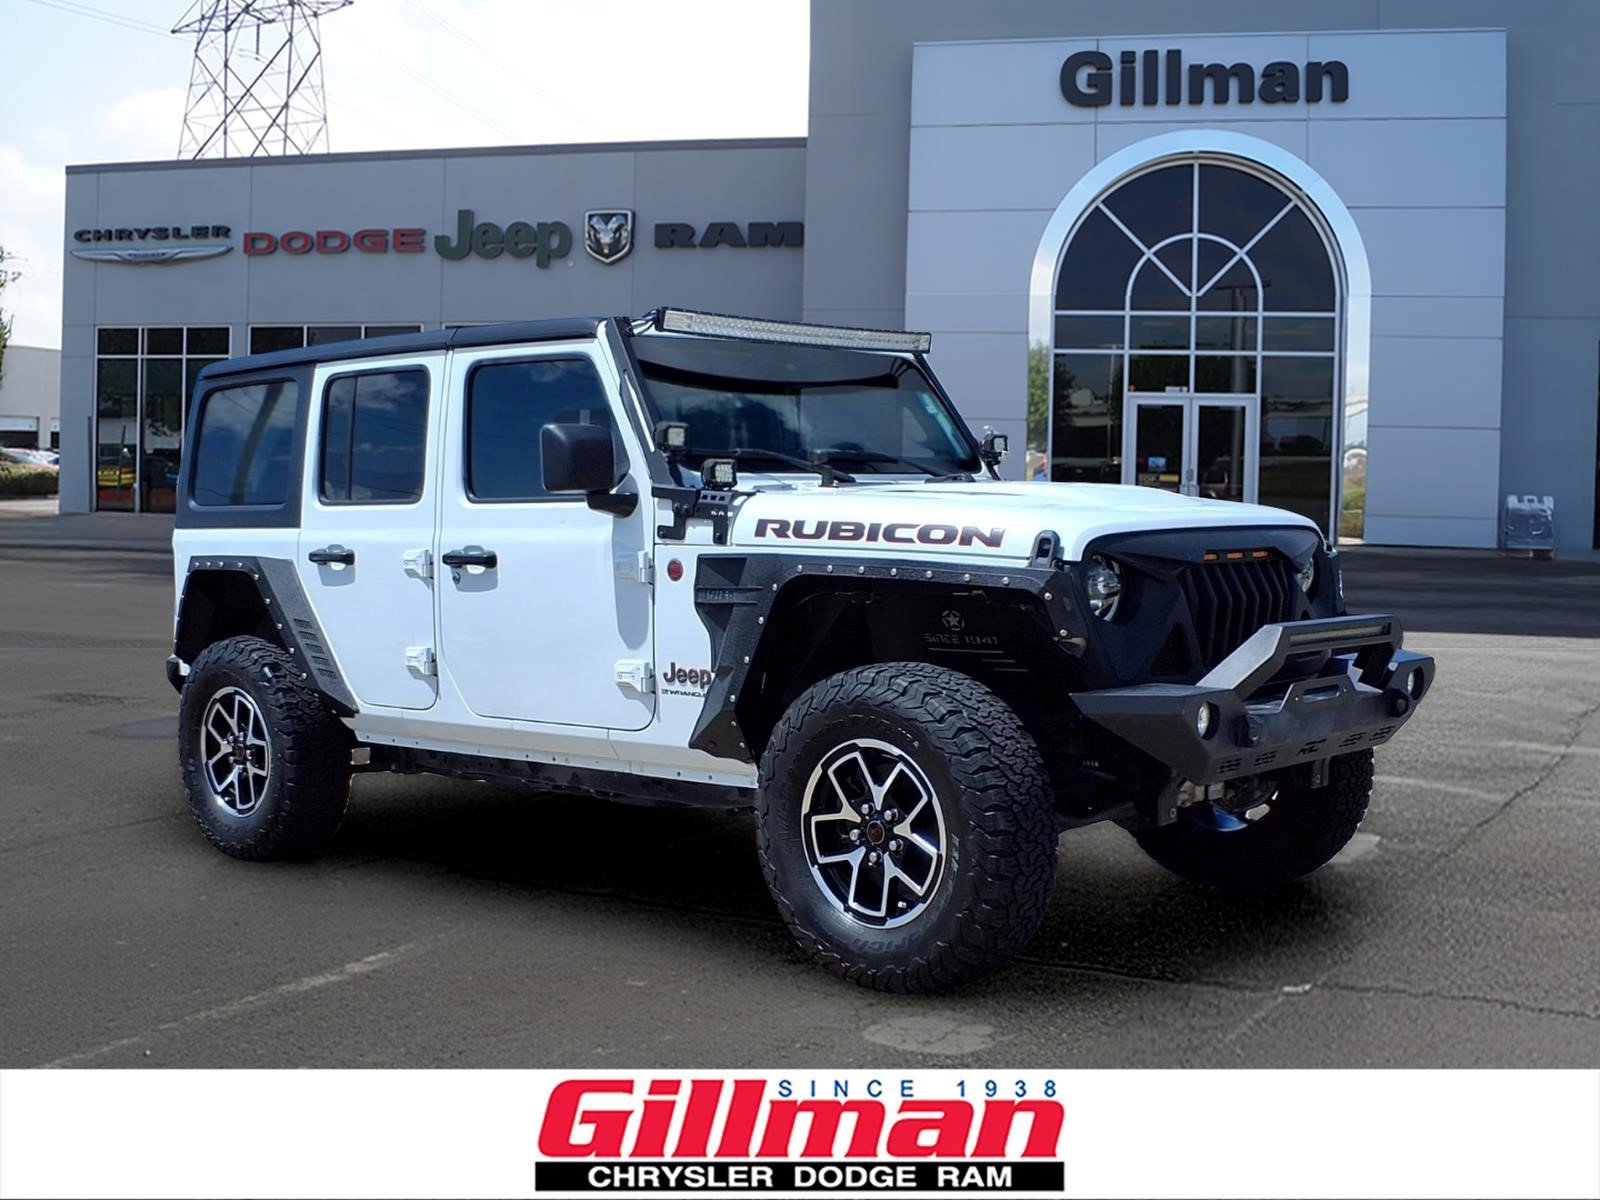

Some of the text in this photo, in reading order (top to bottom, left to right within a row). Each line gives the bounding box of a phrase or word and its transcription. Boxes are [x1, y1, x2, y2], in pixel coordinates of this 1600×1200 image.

[1060, 48, 1349, 107] Gillman
[73, 224, 232, 243] CHRYSLER
[243, 228, 426, 255] DODGE
[434, 209, 573, 269] Jeep
[654, 221, 804, 248] RAM
[754, 518, 1006, 548] RUBICON
[663, 662, 712, 690] Jeep
